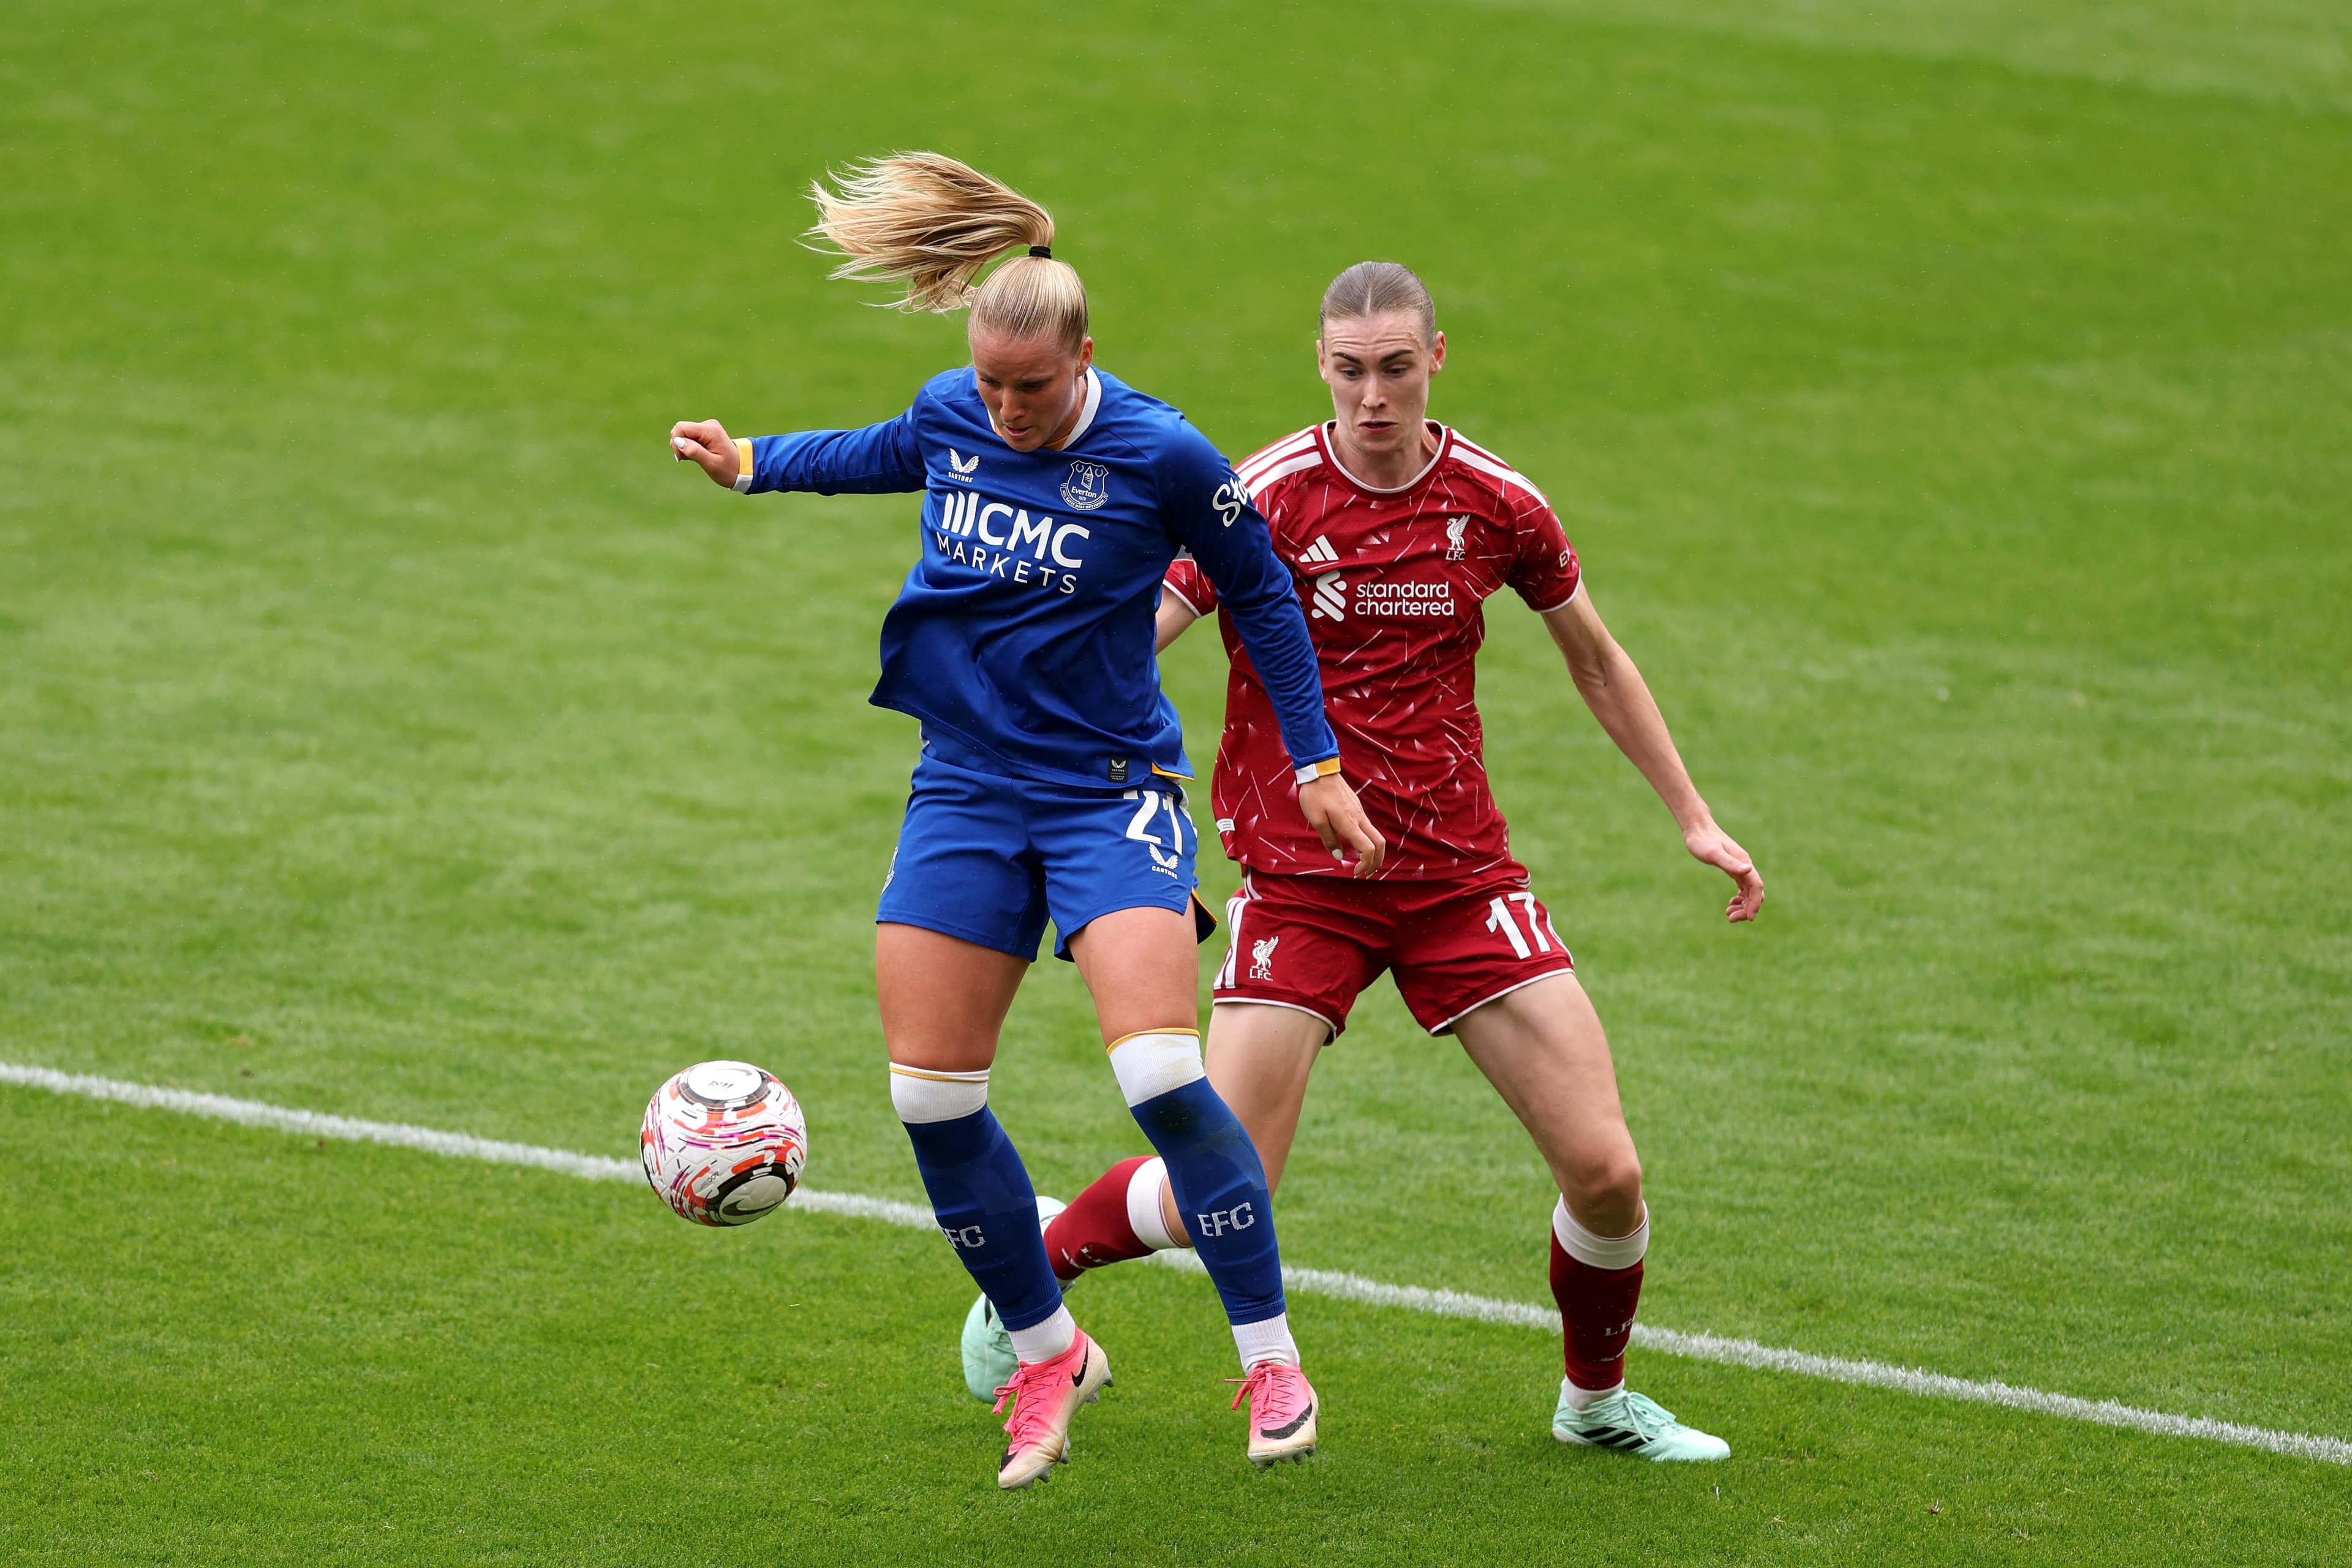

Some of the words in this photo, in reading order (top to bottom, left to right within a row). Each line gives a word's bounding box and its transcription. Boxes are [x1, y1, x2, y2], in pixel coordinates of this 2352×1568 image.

[948, 472, 973, 483] CASTORE
[1071, 486, 1097, 498] Everton
[978, 503, 1090, 568] CMC
[937, 532, 1077, 594] MARKETS
[1356, 581, 1449, 598] standard
[1355, 598, 1454, 616] chartered
[1123, 790, 1182, 856] 21
[1152, 865, 1178, 880] CASTORE
[1485, 892, 1551, 960] 17
[1197, 1202, 1254, 1236] EFC
[941, 1226, 986, 1250] FC
